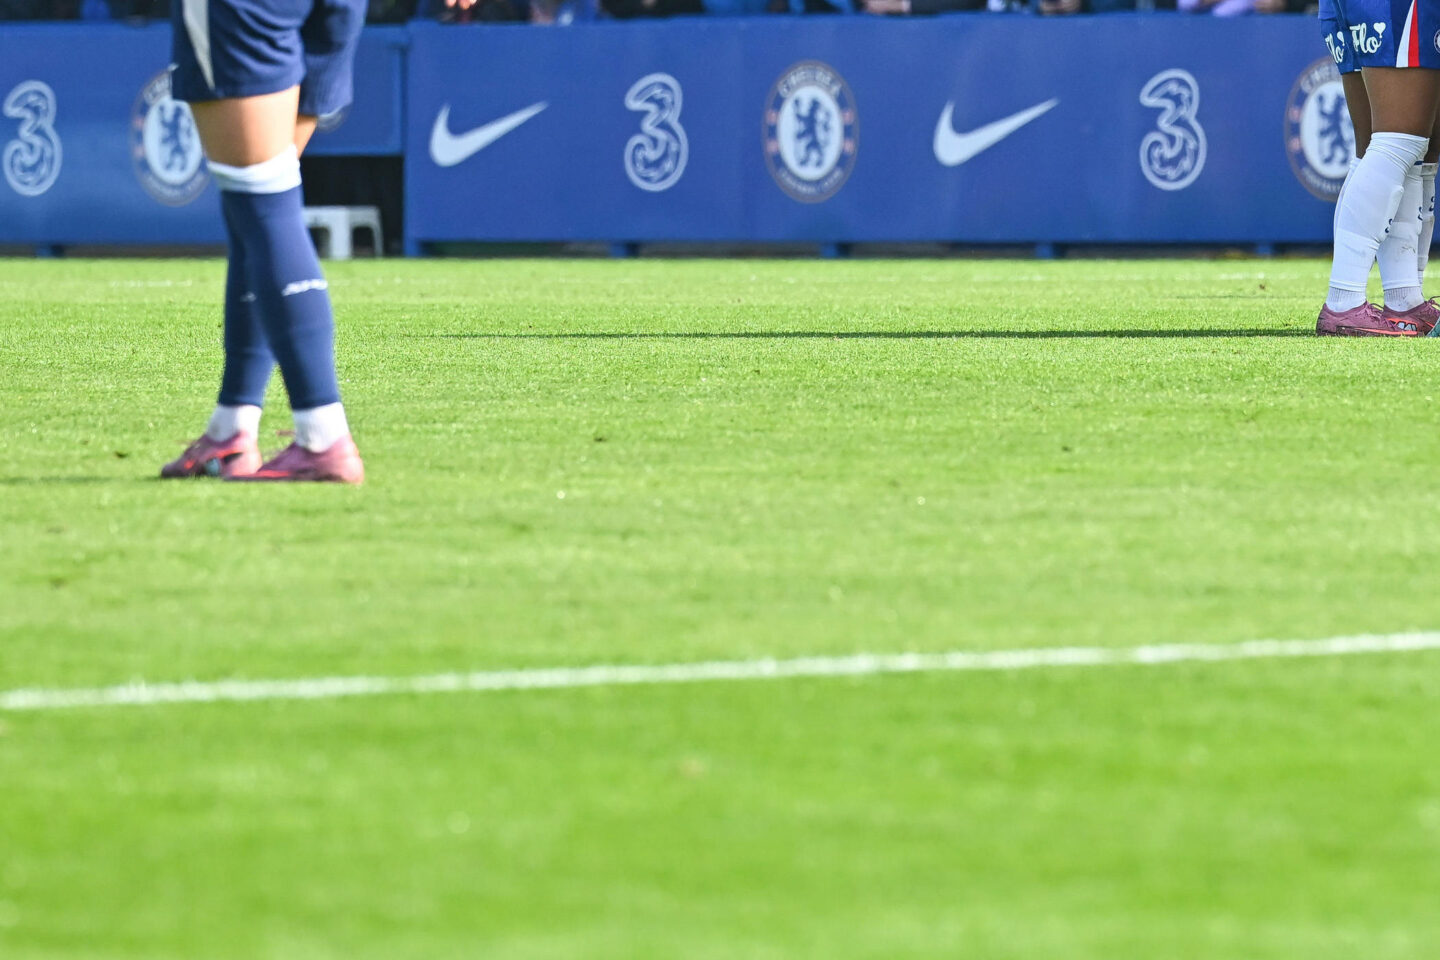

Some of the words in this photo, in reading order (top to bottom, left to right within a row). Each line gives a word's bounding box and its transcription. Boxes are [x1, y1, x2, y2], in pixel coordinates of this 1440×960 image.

[3, 79, 63, 197] 3
[623, 71, 690, 193] 3
[1138, 67, 1208, 192] 3
